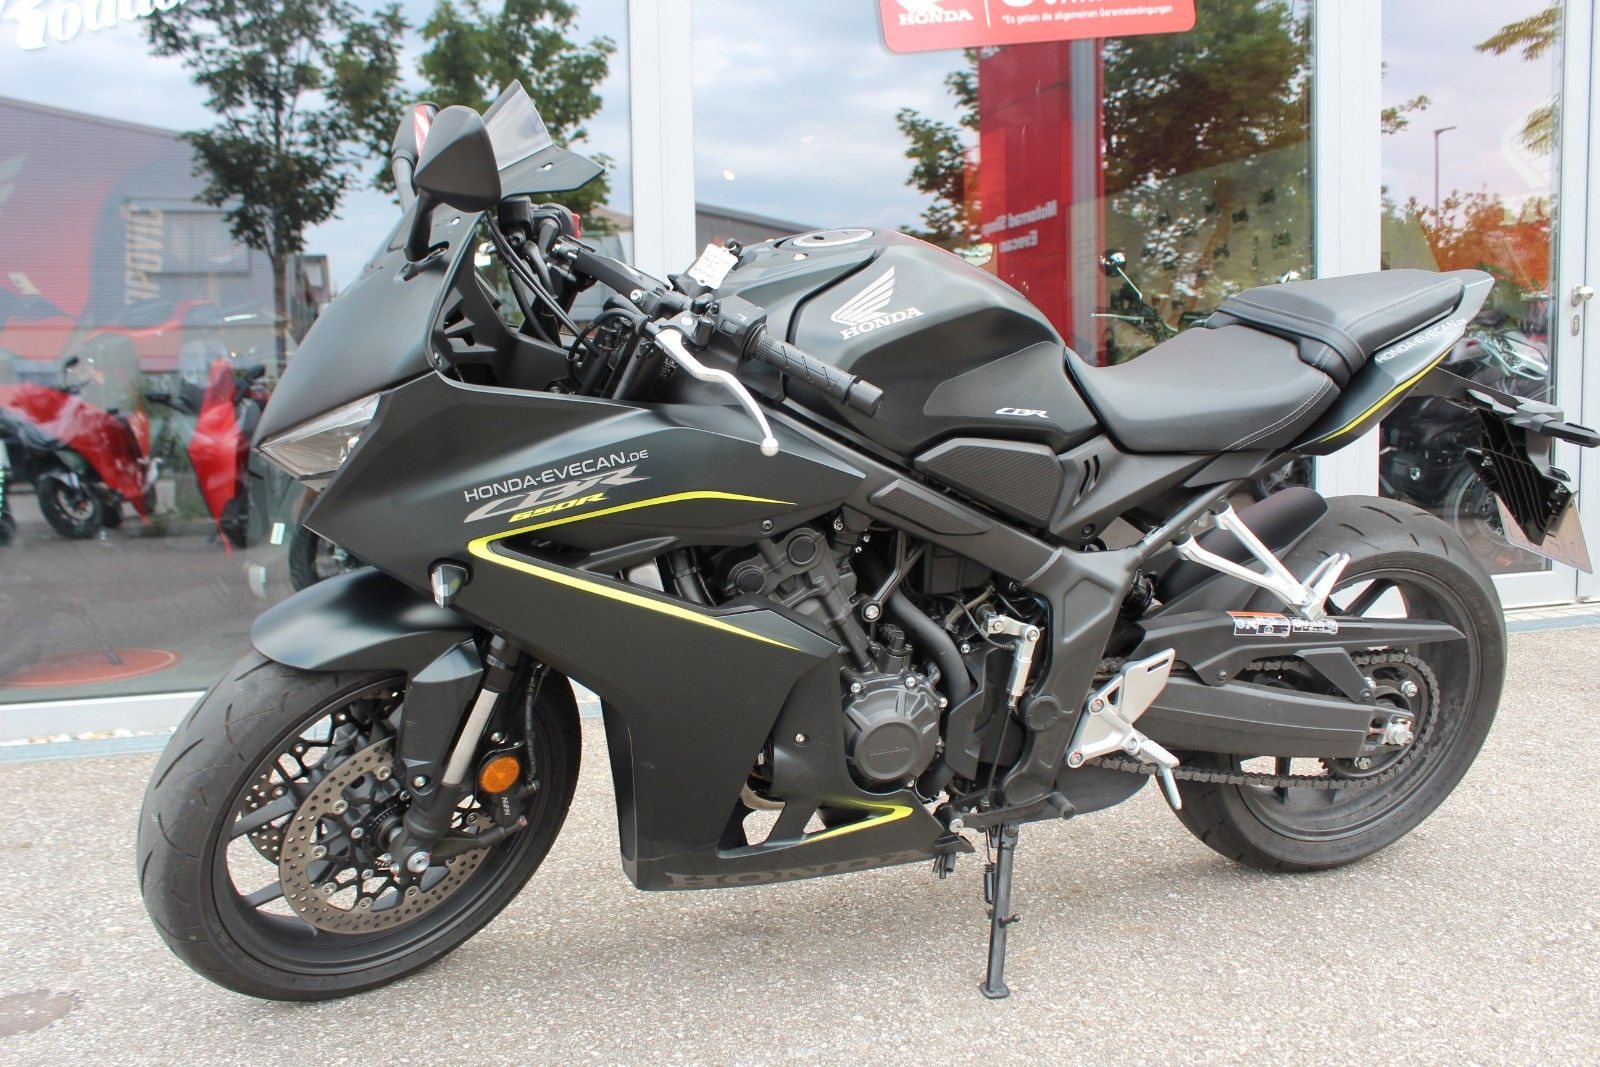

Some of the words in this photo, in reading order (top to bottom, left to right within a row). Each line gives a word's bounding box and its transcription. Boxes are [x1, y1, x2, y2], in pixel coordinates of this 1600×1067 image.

[898, 9, 974, 25] HONDA
[1017, 13, 1040, 24] gelten
[1041, 12, 1053, 21] die
[1054, 10, 1099, 22] allgemeinen
[1099, 5, 1173, 17] Garantiebedingungen
[839, 307, 925, 340] HONDA
[995, 407, 1050, 419] CBR
[464, 449, 649, 502] HONDA-EVECAN.DE
[463, 465, 650, 523] CBR
[508, 492, 608, 523] 650R
